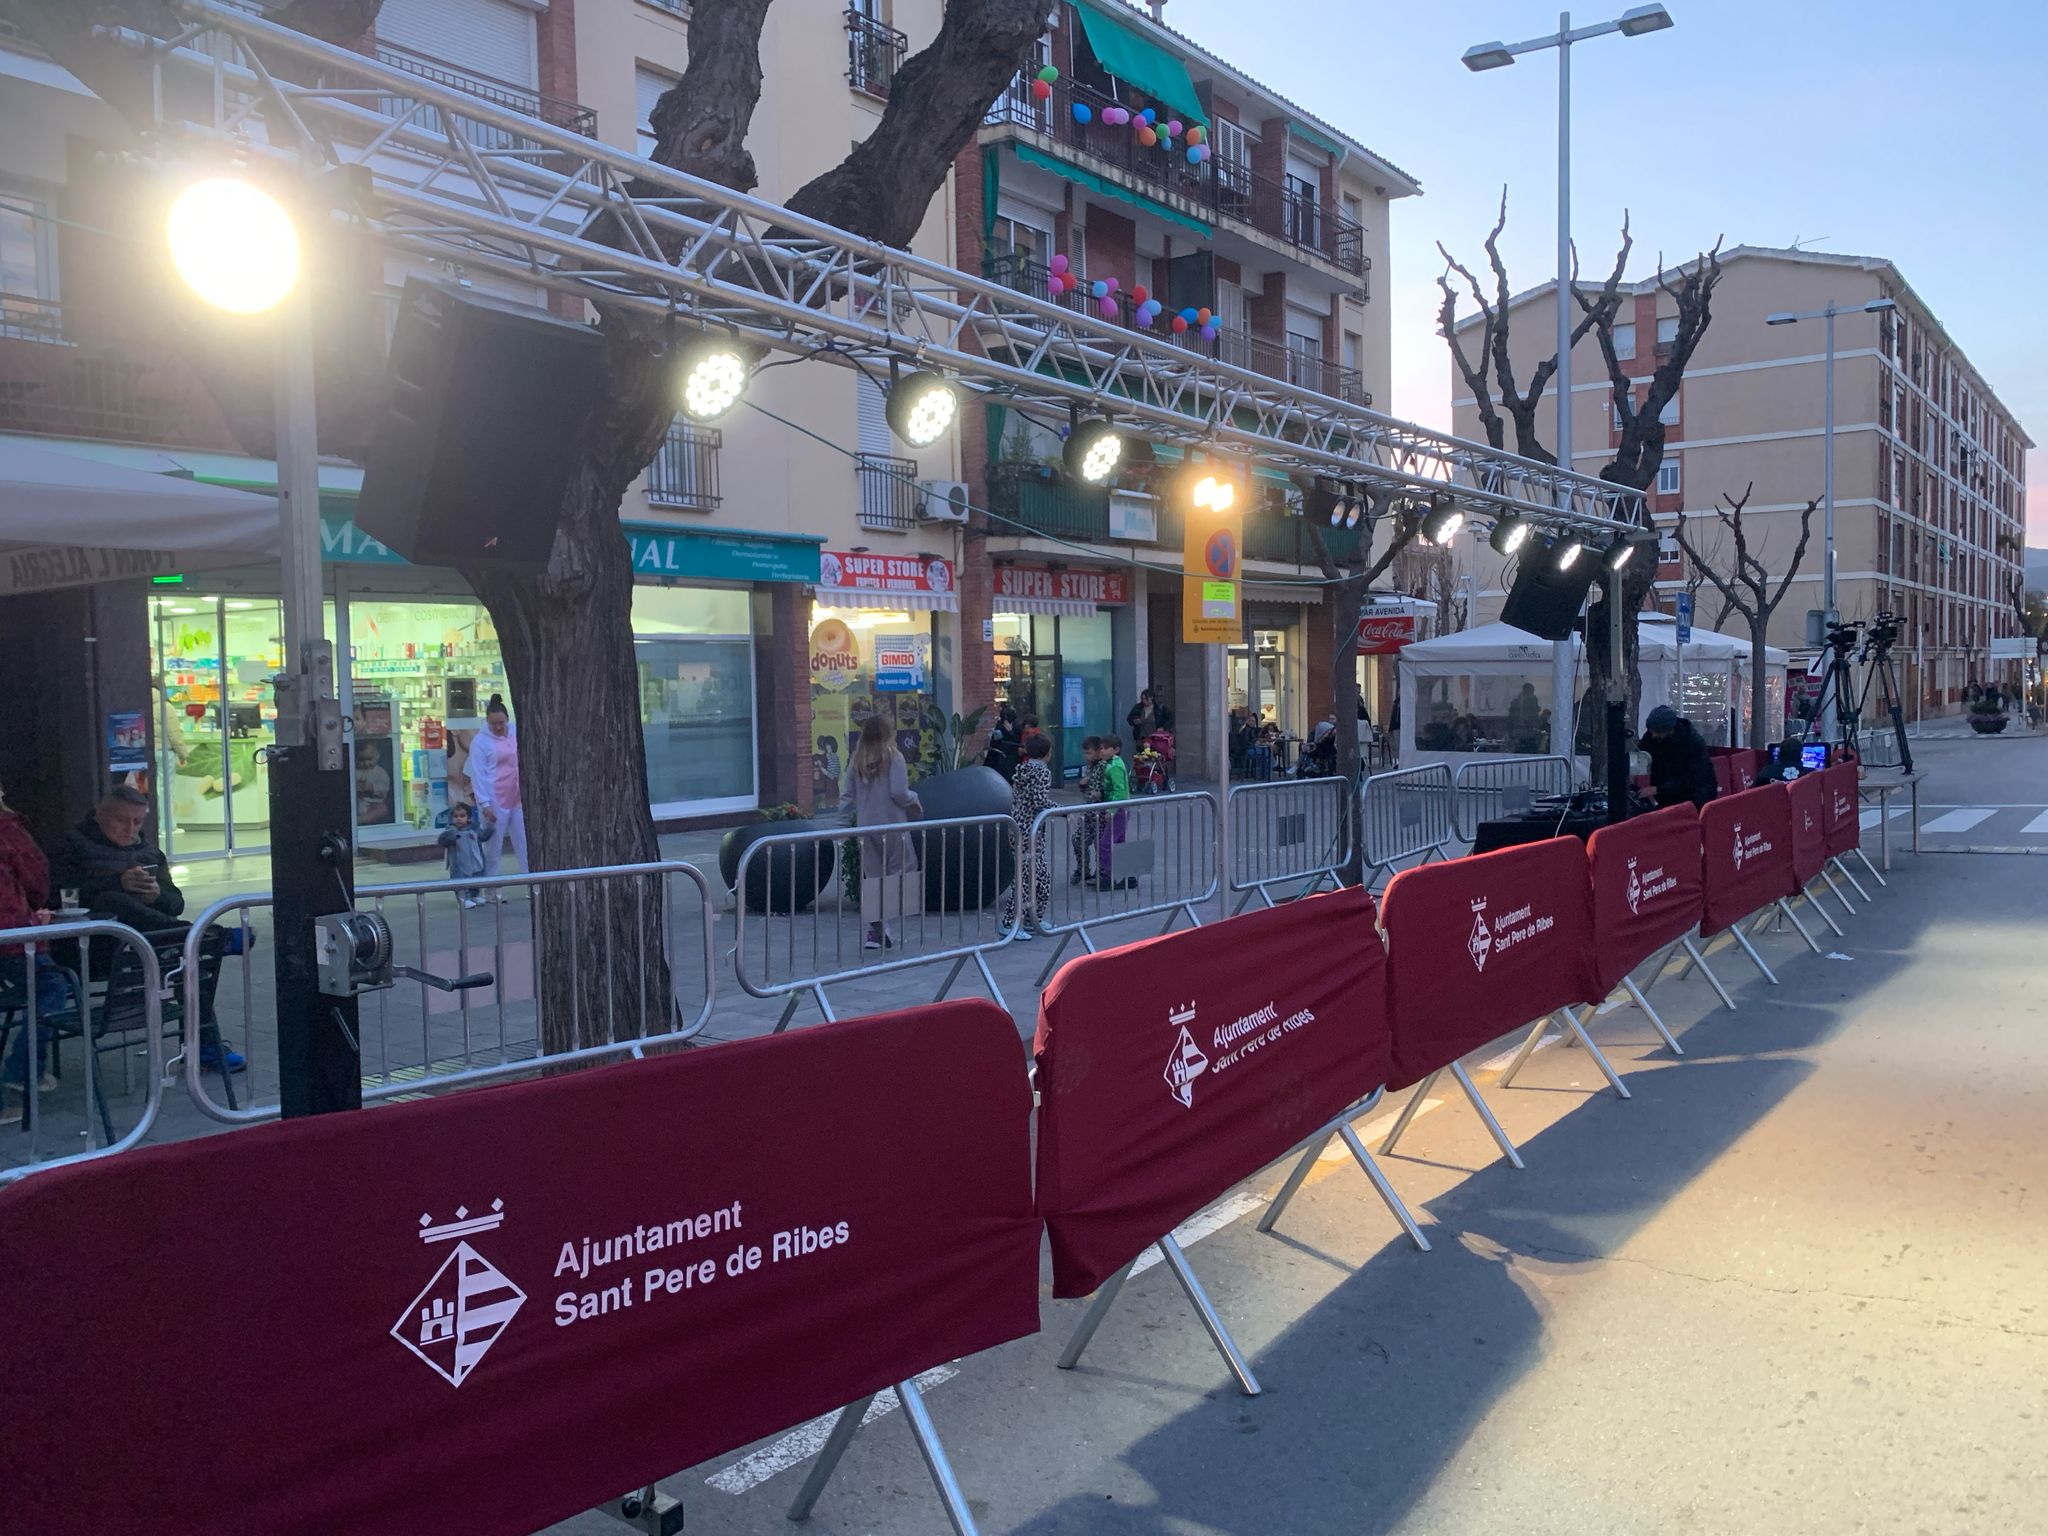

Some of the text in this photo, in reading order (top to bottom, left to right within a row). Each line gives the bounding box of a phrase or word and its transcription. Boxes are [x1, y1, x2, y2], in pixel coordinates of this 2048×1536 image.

[844, 556, 924, 578] SUPER STORE
[1002, 569, 1106, 599] SUPER STORE
[1375, 606, 1405, 616] AVENIDA
[811, 652, 858, 672] donuts
[881, 653, 915, 666] BIMBO
[1494, 903, 1531, 933] Ajuntament
[1495, 915, 1554, 953] Sant Pere de Ribes
[1213, 1000, 1278, 1049] Ajuntament
[554, 1200, 743, 1279] Ajuntament
[554, 1220, 850, 1327] Sant Pere de Ribes
